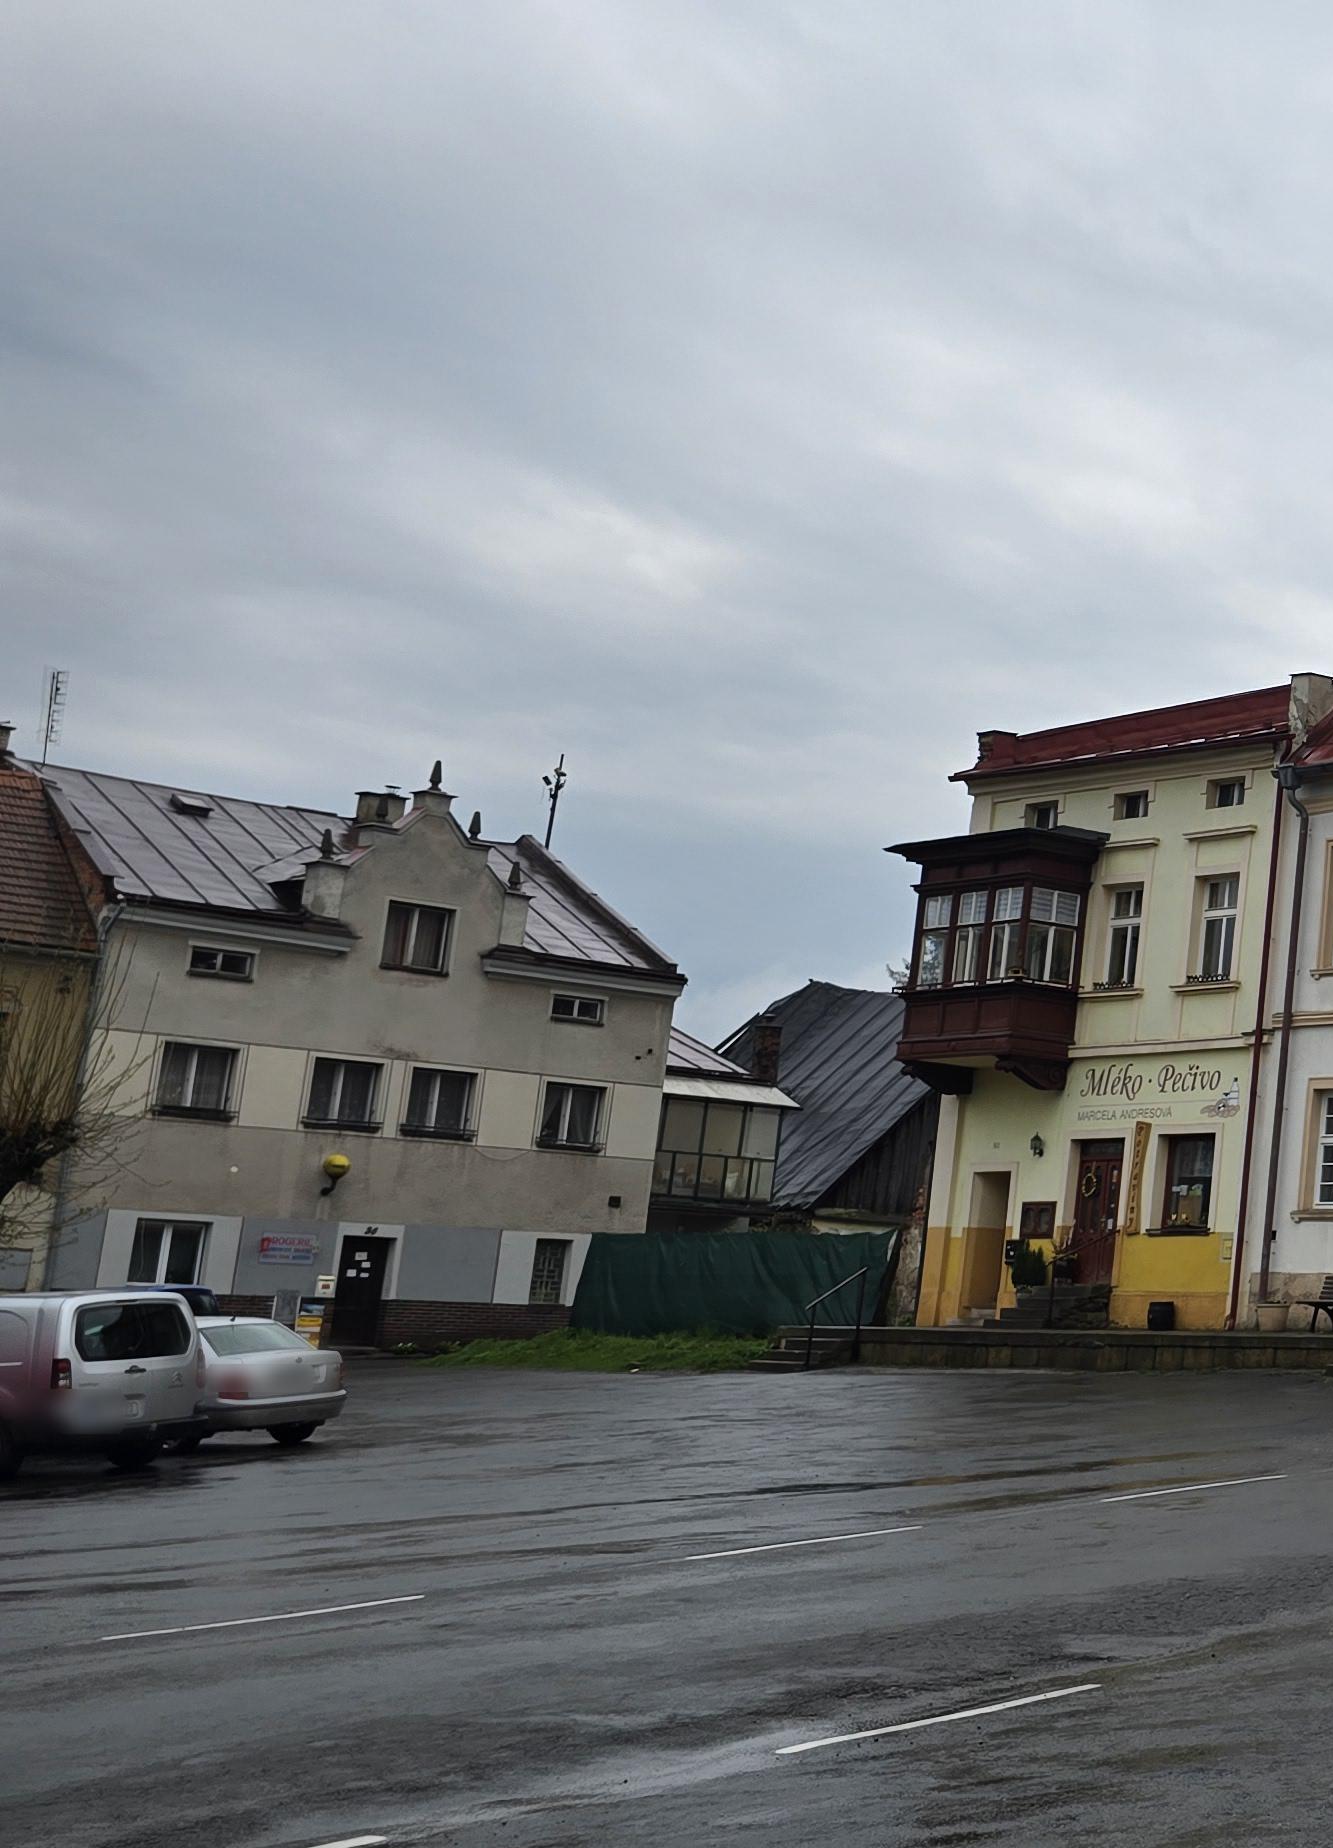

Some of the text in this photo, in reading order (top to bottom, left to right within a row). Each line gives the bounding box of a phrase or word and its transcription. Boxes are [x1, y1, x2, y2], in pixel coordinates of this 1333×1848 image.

[1080, 1063, 1221, 1100] Mléko Pečivo
[1077, 1105, 1173, 1121] MARCELA ANDRESOVÁ
